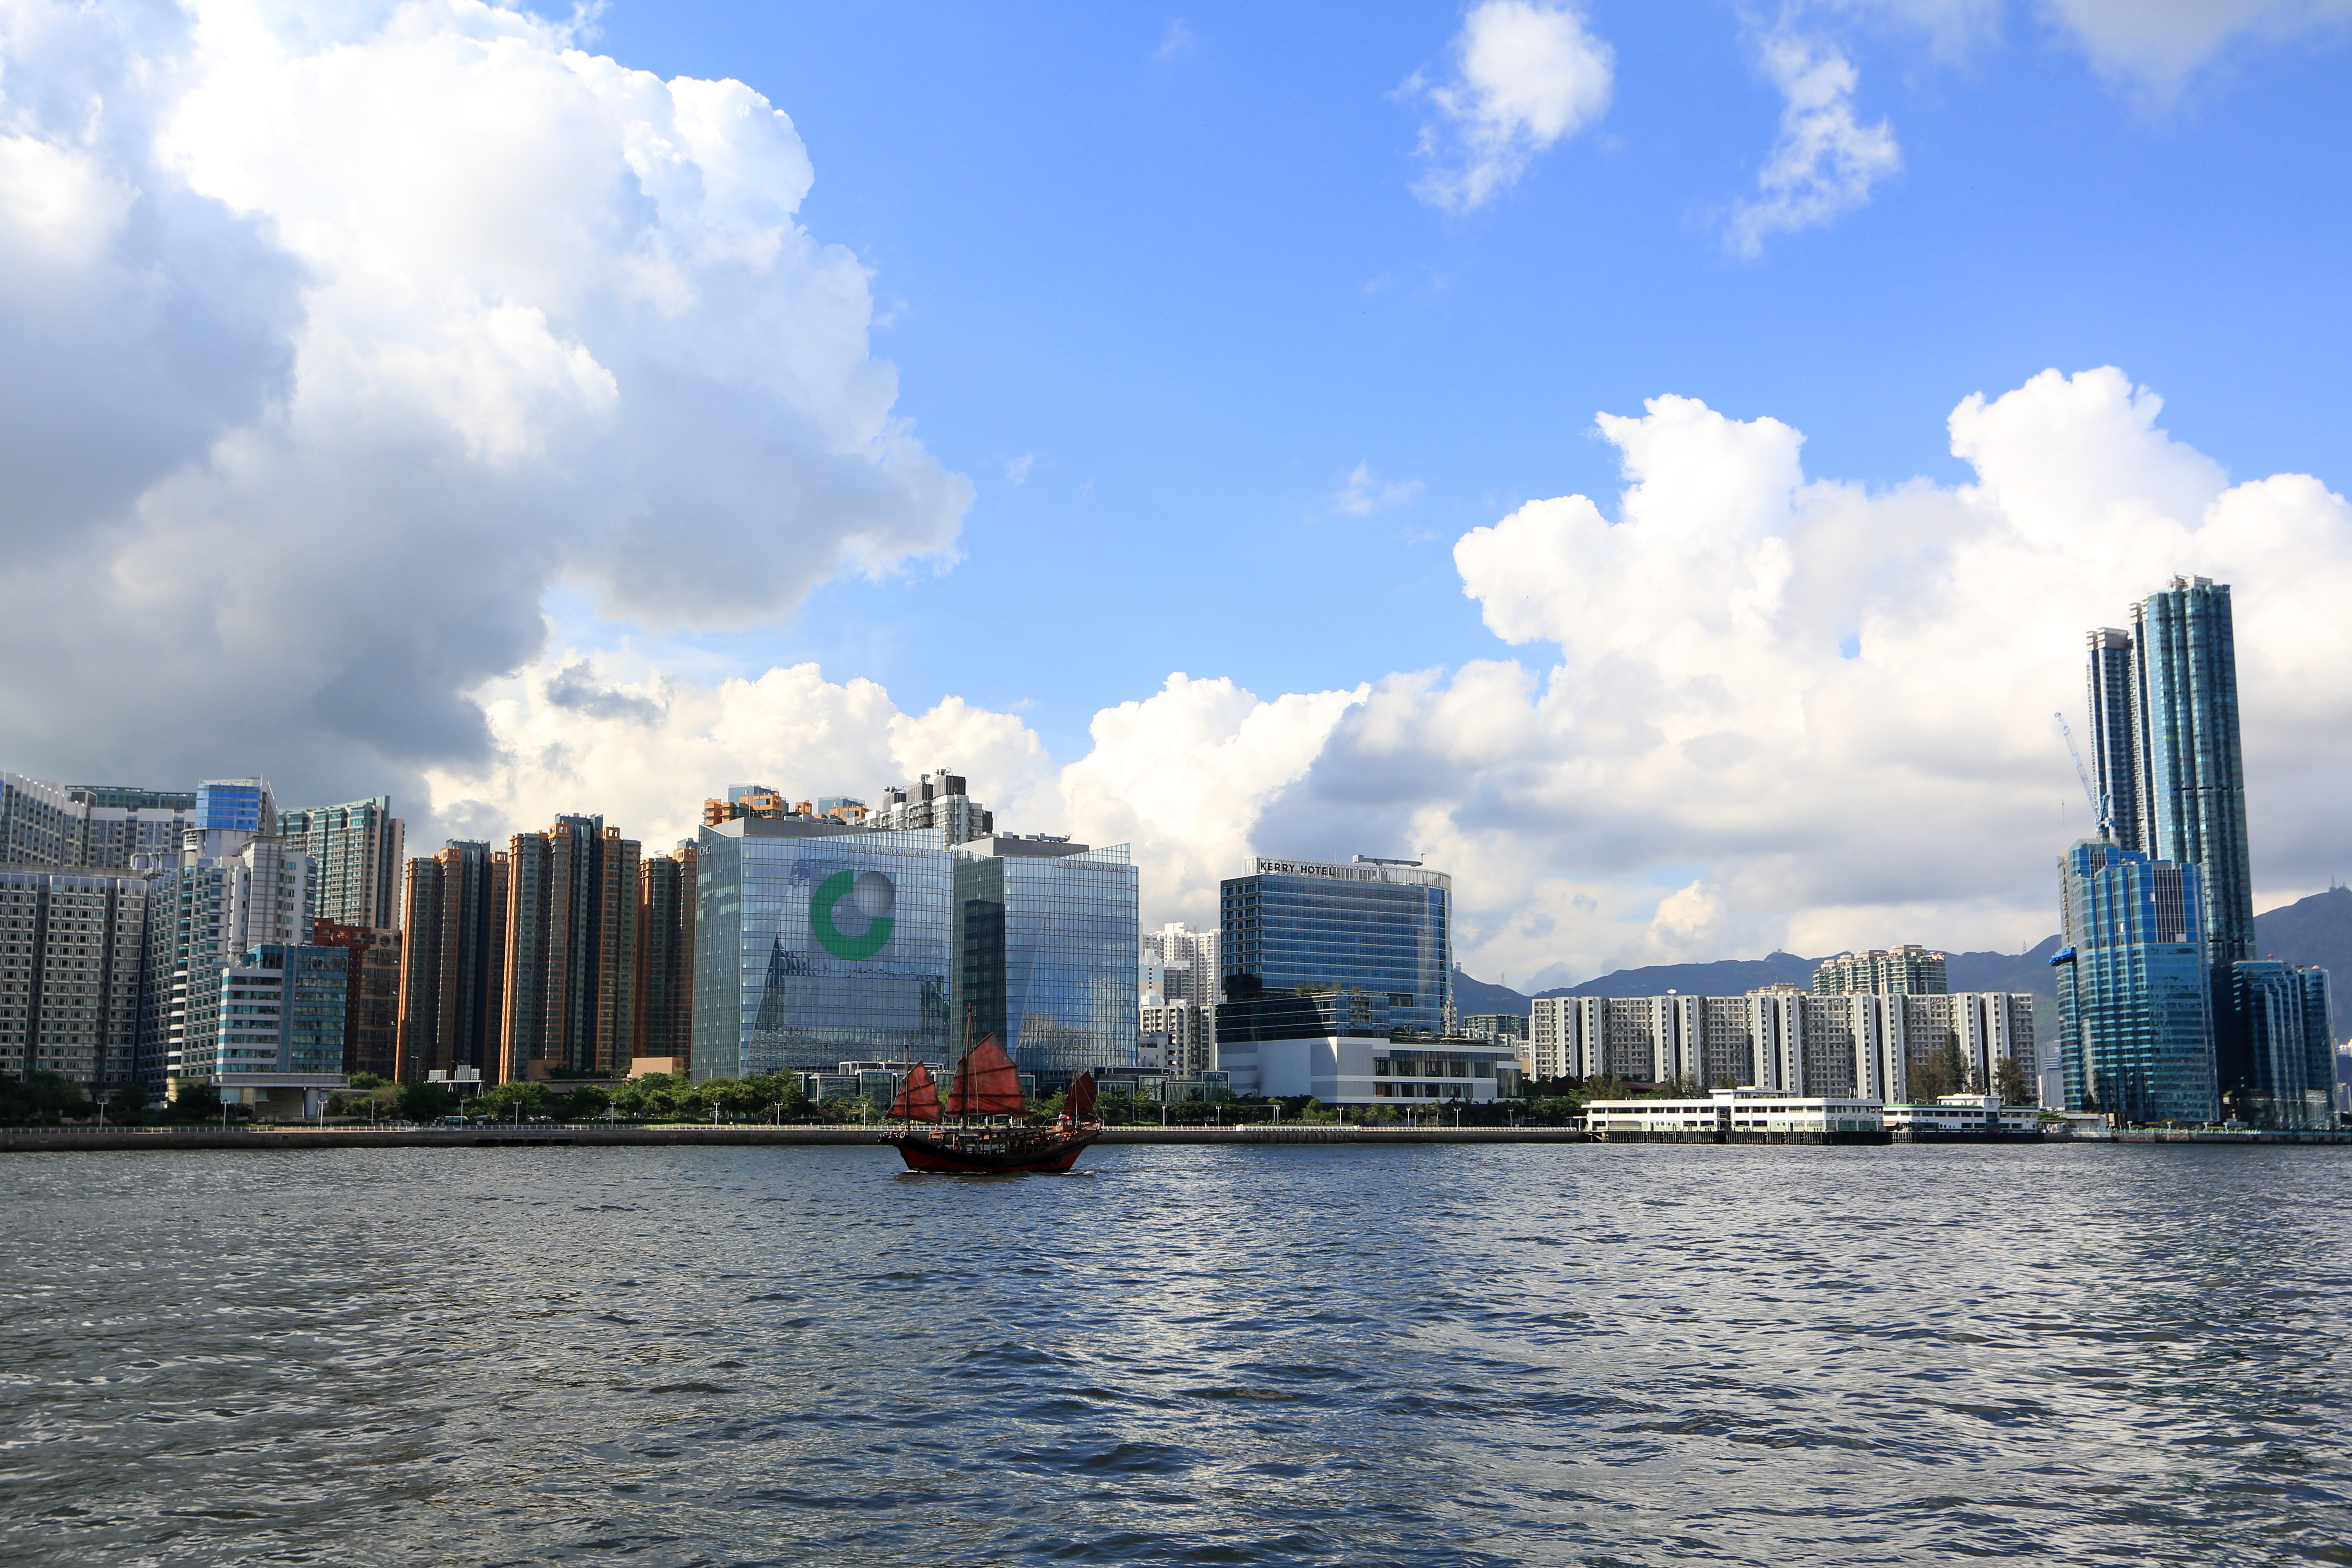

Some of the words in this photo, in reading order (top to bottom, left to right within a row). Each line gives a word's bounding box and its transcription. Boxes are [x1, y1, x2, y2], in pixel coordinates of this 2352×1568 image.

[699, 845, 711, 856] OHG
[851, 844, 870, 853] ONE
[871, 845, 928, 858] HARBOURGATE
[1058, 859, 1074, 869] ONE
[1075, 861, 1126, 872] HARBOURGATE
[1261, 862, 1295, 872] KERRY
[1301, 865, 1334, 875] HOTEL
